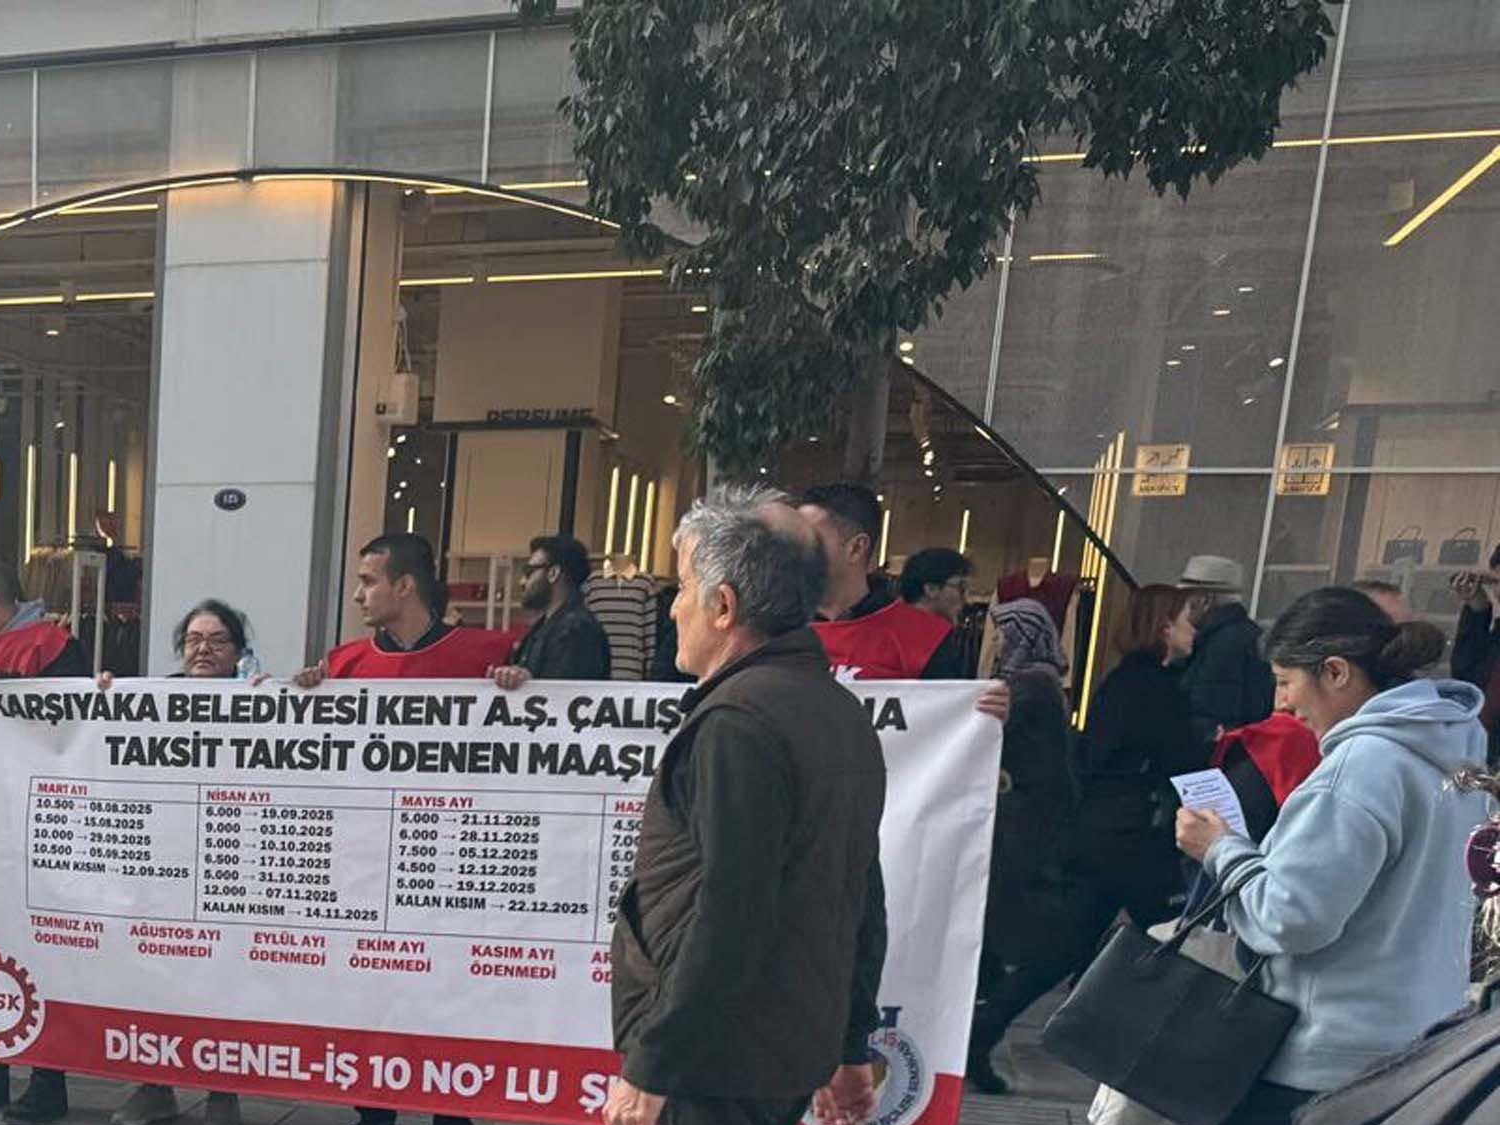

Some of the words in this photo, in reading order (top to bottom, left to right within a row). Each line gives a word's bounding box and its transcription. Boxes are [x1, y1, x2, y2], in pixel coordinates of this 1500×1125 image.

[167, 688, 368, 725] BELEDİYESİ
[376, 695, 477, 726] KENT
[483, 695, 557, 732] A.Ş.
[105, 731, 223, 767] TAKSİT
[230, 733, 355, 771] TAKSİT
[362, 733, 520, 774] ÖDENEN
[206, 788, 246, 801] NİSAN
[249, 791, 271, 803] AYI
[401, 796, 445, 807] MAYIS
[450, 797, 473, 808] AYI
[401, 813, 439, 824] 5.000
[461, 814, 541, 827] 21.11.2025
[260, 824, 333, 837] 03.10.2025
[399, 829, 438, 841] 6.000
[460, 831, 540, 844] 28.11.2025
[205, 838, 240, 849] 5.000
[260, 840, 332, 853] 10.10.2025
[399, 845, 437, 857] 7.500
[459, 847, 538, 861] 05.12.2025
[32, 858, 70, 871] KALAN
[73, 860, 106, 873] KISIM
[122, 865, 189, 879] 12.09.2025
[259, 856, 331, 869] 17.10.2025
[398, 862, 436, 873] 4.500
[458, 864, 537, 877] 12.12.2025
[258, 872, 330, 885] 31.10.2025
[396, 878, 435, 891] 5.000
[457, 880, 536, 894] 19.12.2025
[204, 885, 246, 897] 12.000
[265, 888, 338, 902] 07.11.2025
[203, 901, 245, 914] KALAN
[249, 904, 285, 916] KISIM
[305, 907, 378, 921] 14.11.2025
[395, 895, 441, 908] KALAN
[445, 897, 486, 910] KISIM
[508, 900, 589, 914] 22.12.2025
[30, 915, 80, 931] TEMMUZ
[83, 919, 104, 933] AYI
[130, 923, 194, 940] AĞUSTOS
[198, 929, 221, 941] AYI
[35, 932, 99, 950] ÖDENMEDİ
[254, 931, 298, 946] EYLÜL
[302, 935, 326, 948] AYI
[357, 937, 395, 952] EKİM
[400, 941, 425, 954] AYI
[138, 940, 213, 958] ÖDENMEDİ
[472, 944, 523, 959] KASIM
[528, 948, 554, 961] AYI
[249, 949, 326, 967] ÖDENMEDİ
[349, 955, 432, 973] ÖDENMEDİ
[470, 960, 557, 979] ÖDENMEDİ
[105, 1024, 185, 1069] DİSK
[192, 1038, 359, 1091] GENEL-İŞ
[369, 1055, 412, 1090] 10
[506, 1066, 558, 1104] LU
